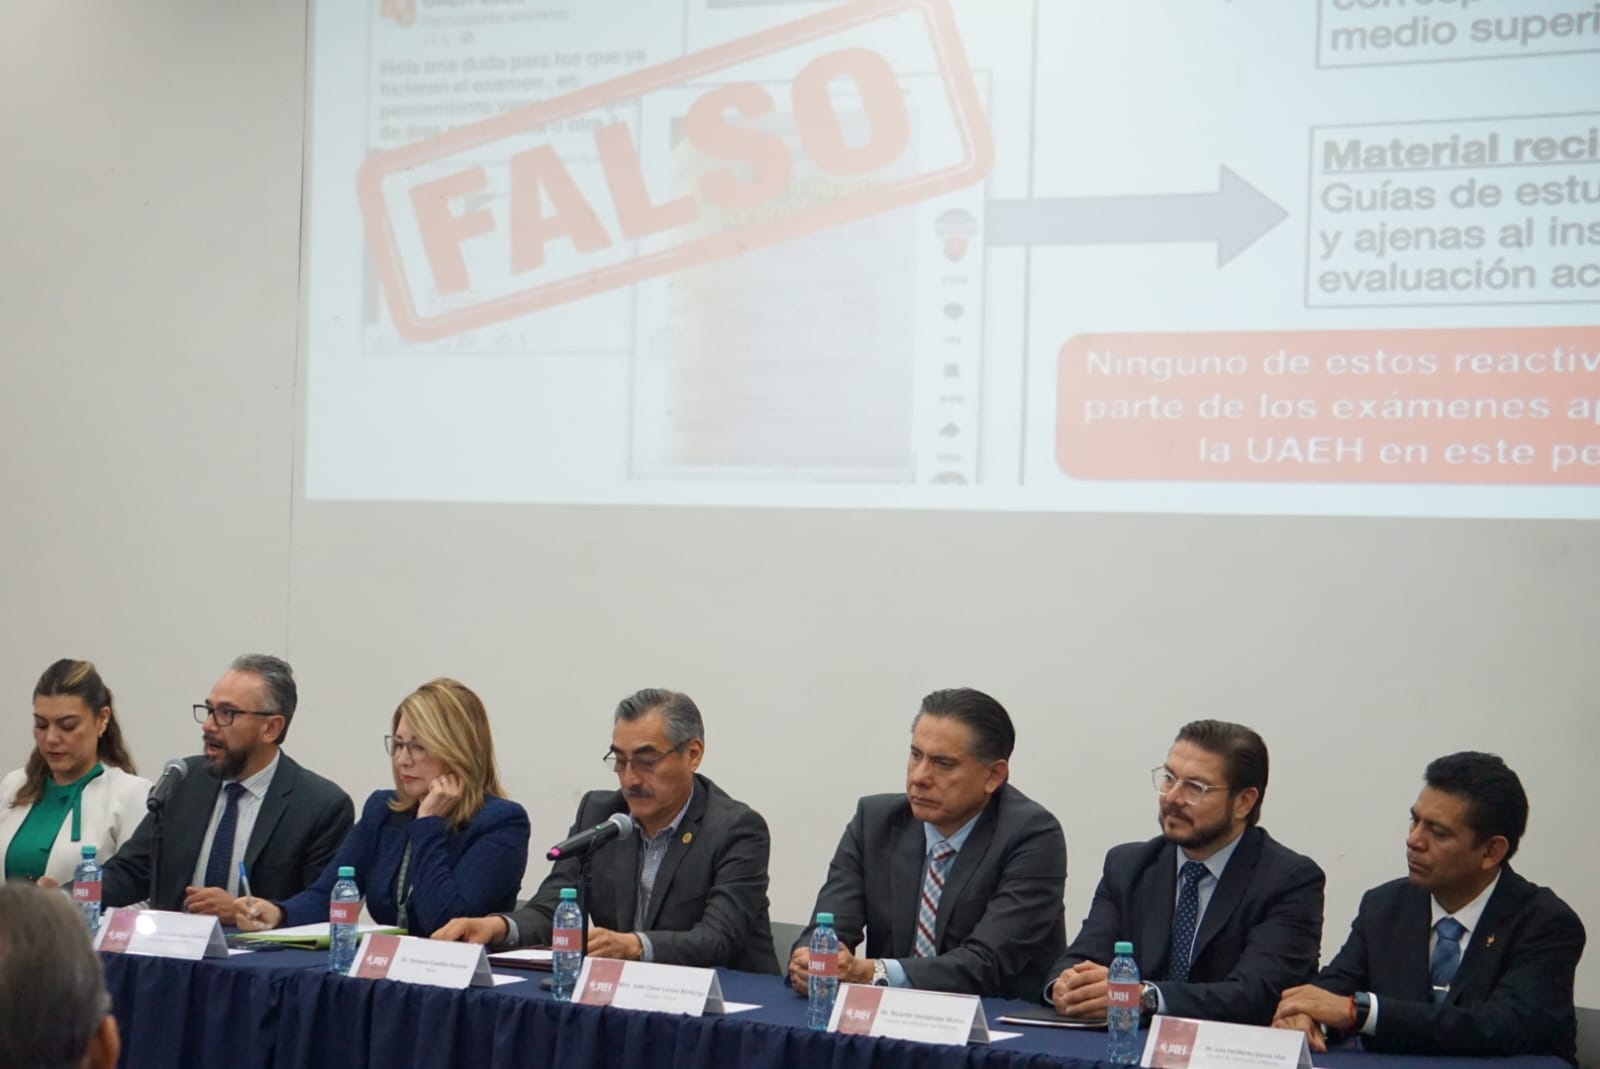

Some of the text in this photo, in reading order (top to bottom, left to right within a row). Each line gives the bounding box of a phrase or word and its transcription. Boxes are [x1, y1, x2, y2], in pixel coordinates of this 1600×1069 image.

[1331, 3, 1600, 50] medio superi
[1323, 127, 1599, 170] Material reci
[408, 47, 911, 296] FALSO
[1321, 175, 1600, 213] Guías de estu
[1319, 229, 1343, 260] y
[1354, 222, 1486, 259] ajenas
[1499, 217, 1534, 249] al
[1318, 258, 1536, 293] evaluación
[1086, 345, 1600, 382] Ninguno de estos reactiv
[1083, 390, 1600, 425] parte de los exámenes a
[1200, 436, 1600, 472] la UAEH en este pe
